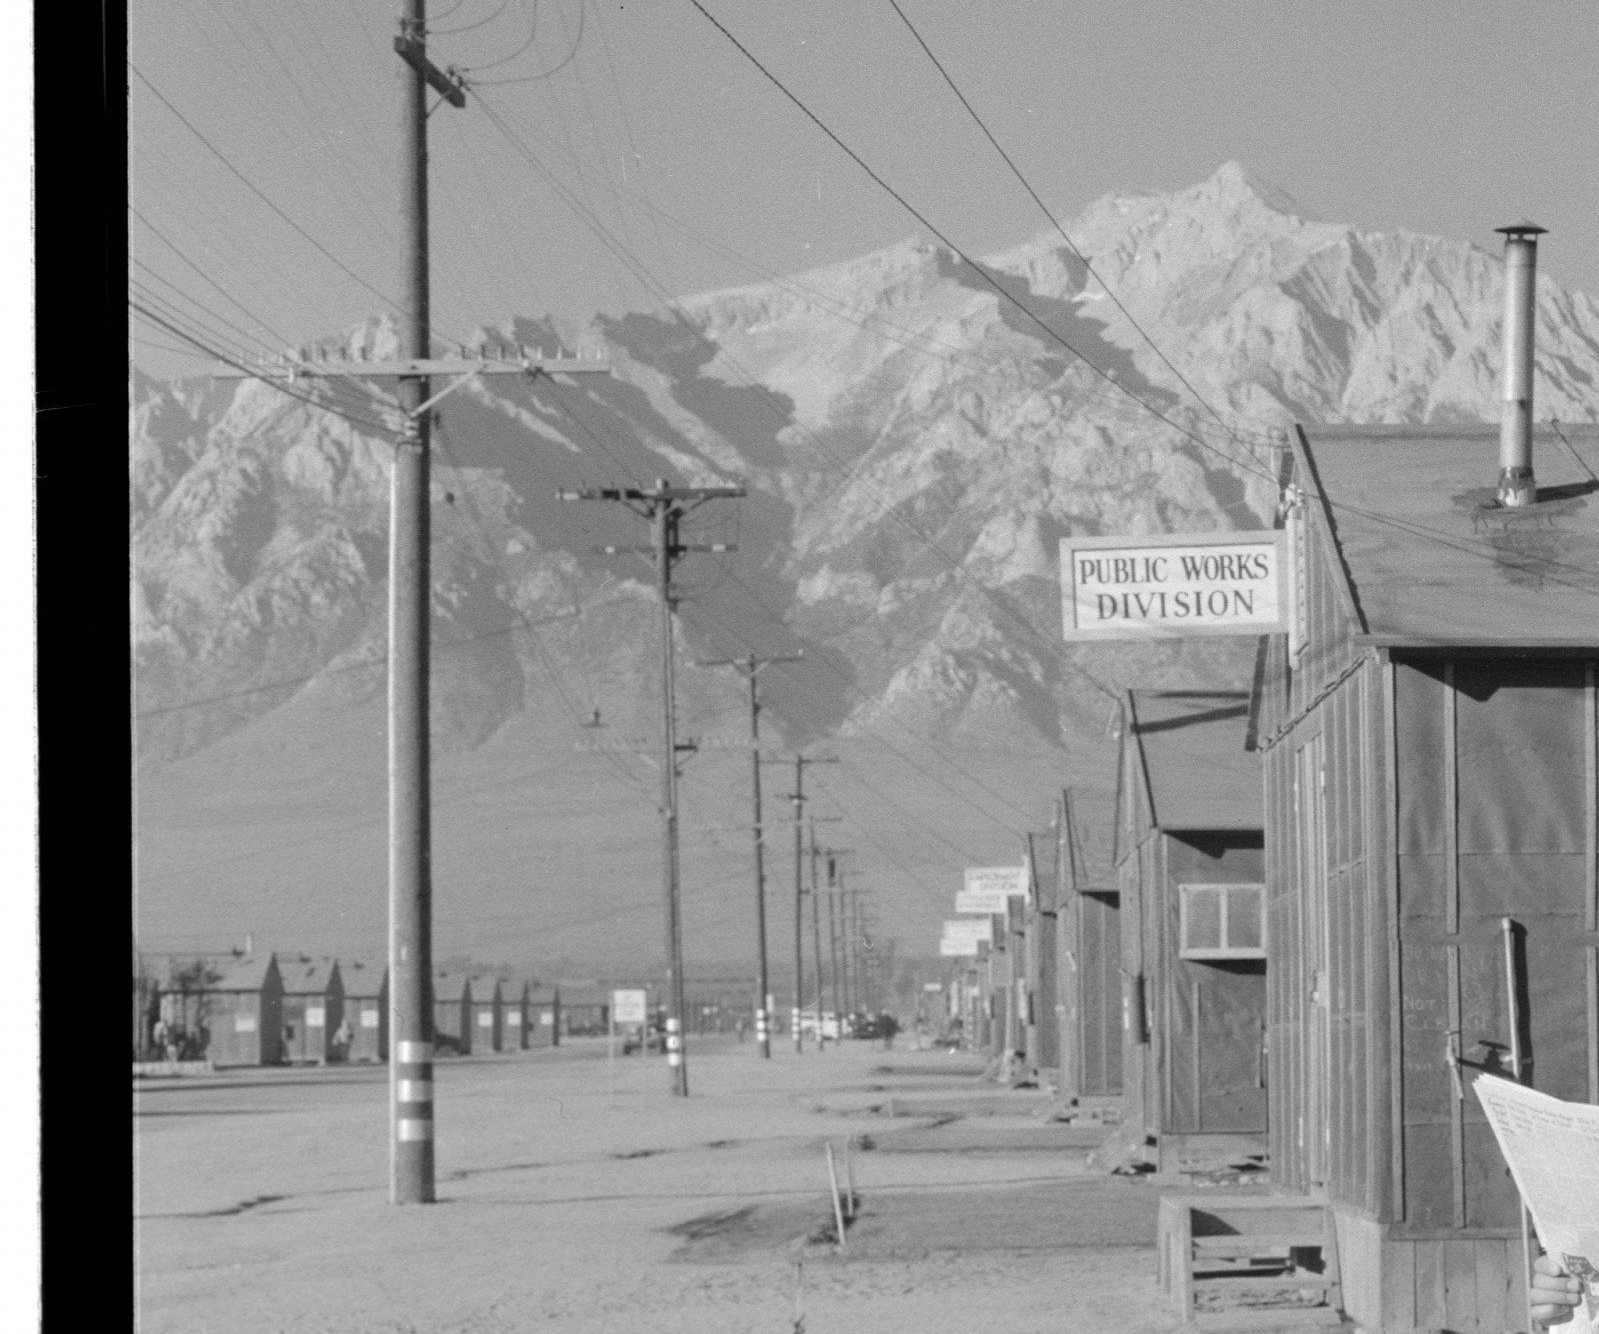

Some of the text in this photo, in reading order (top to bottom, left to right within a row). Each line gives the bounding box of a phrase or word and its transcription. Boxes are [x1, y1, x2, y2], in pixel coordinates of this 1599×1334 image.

[1078, 553, 1270, 585] PUBLIC WORKS
[1096, 589, 1255, 620] DIVISION
